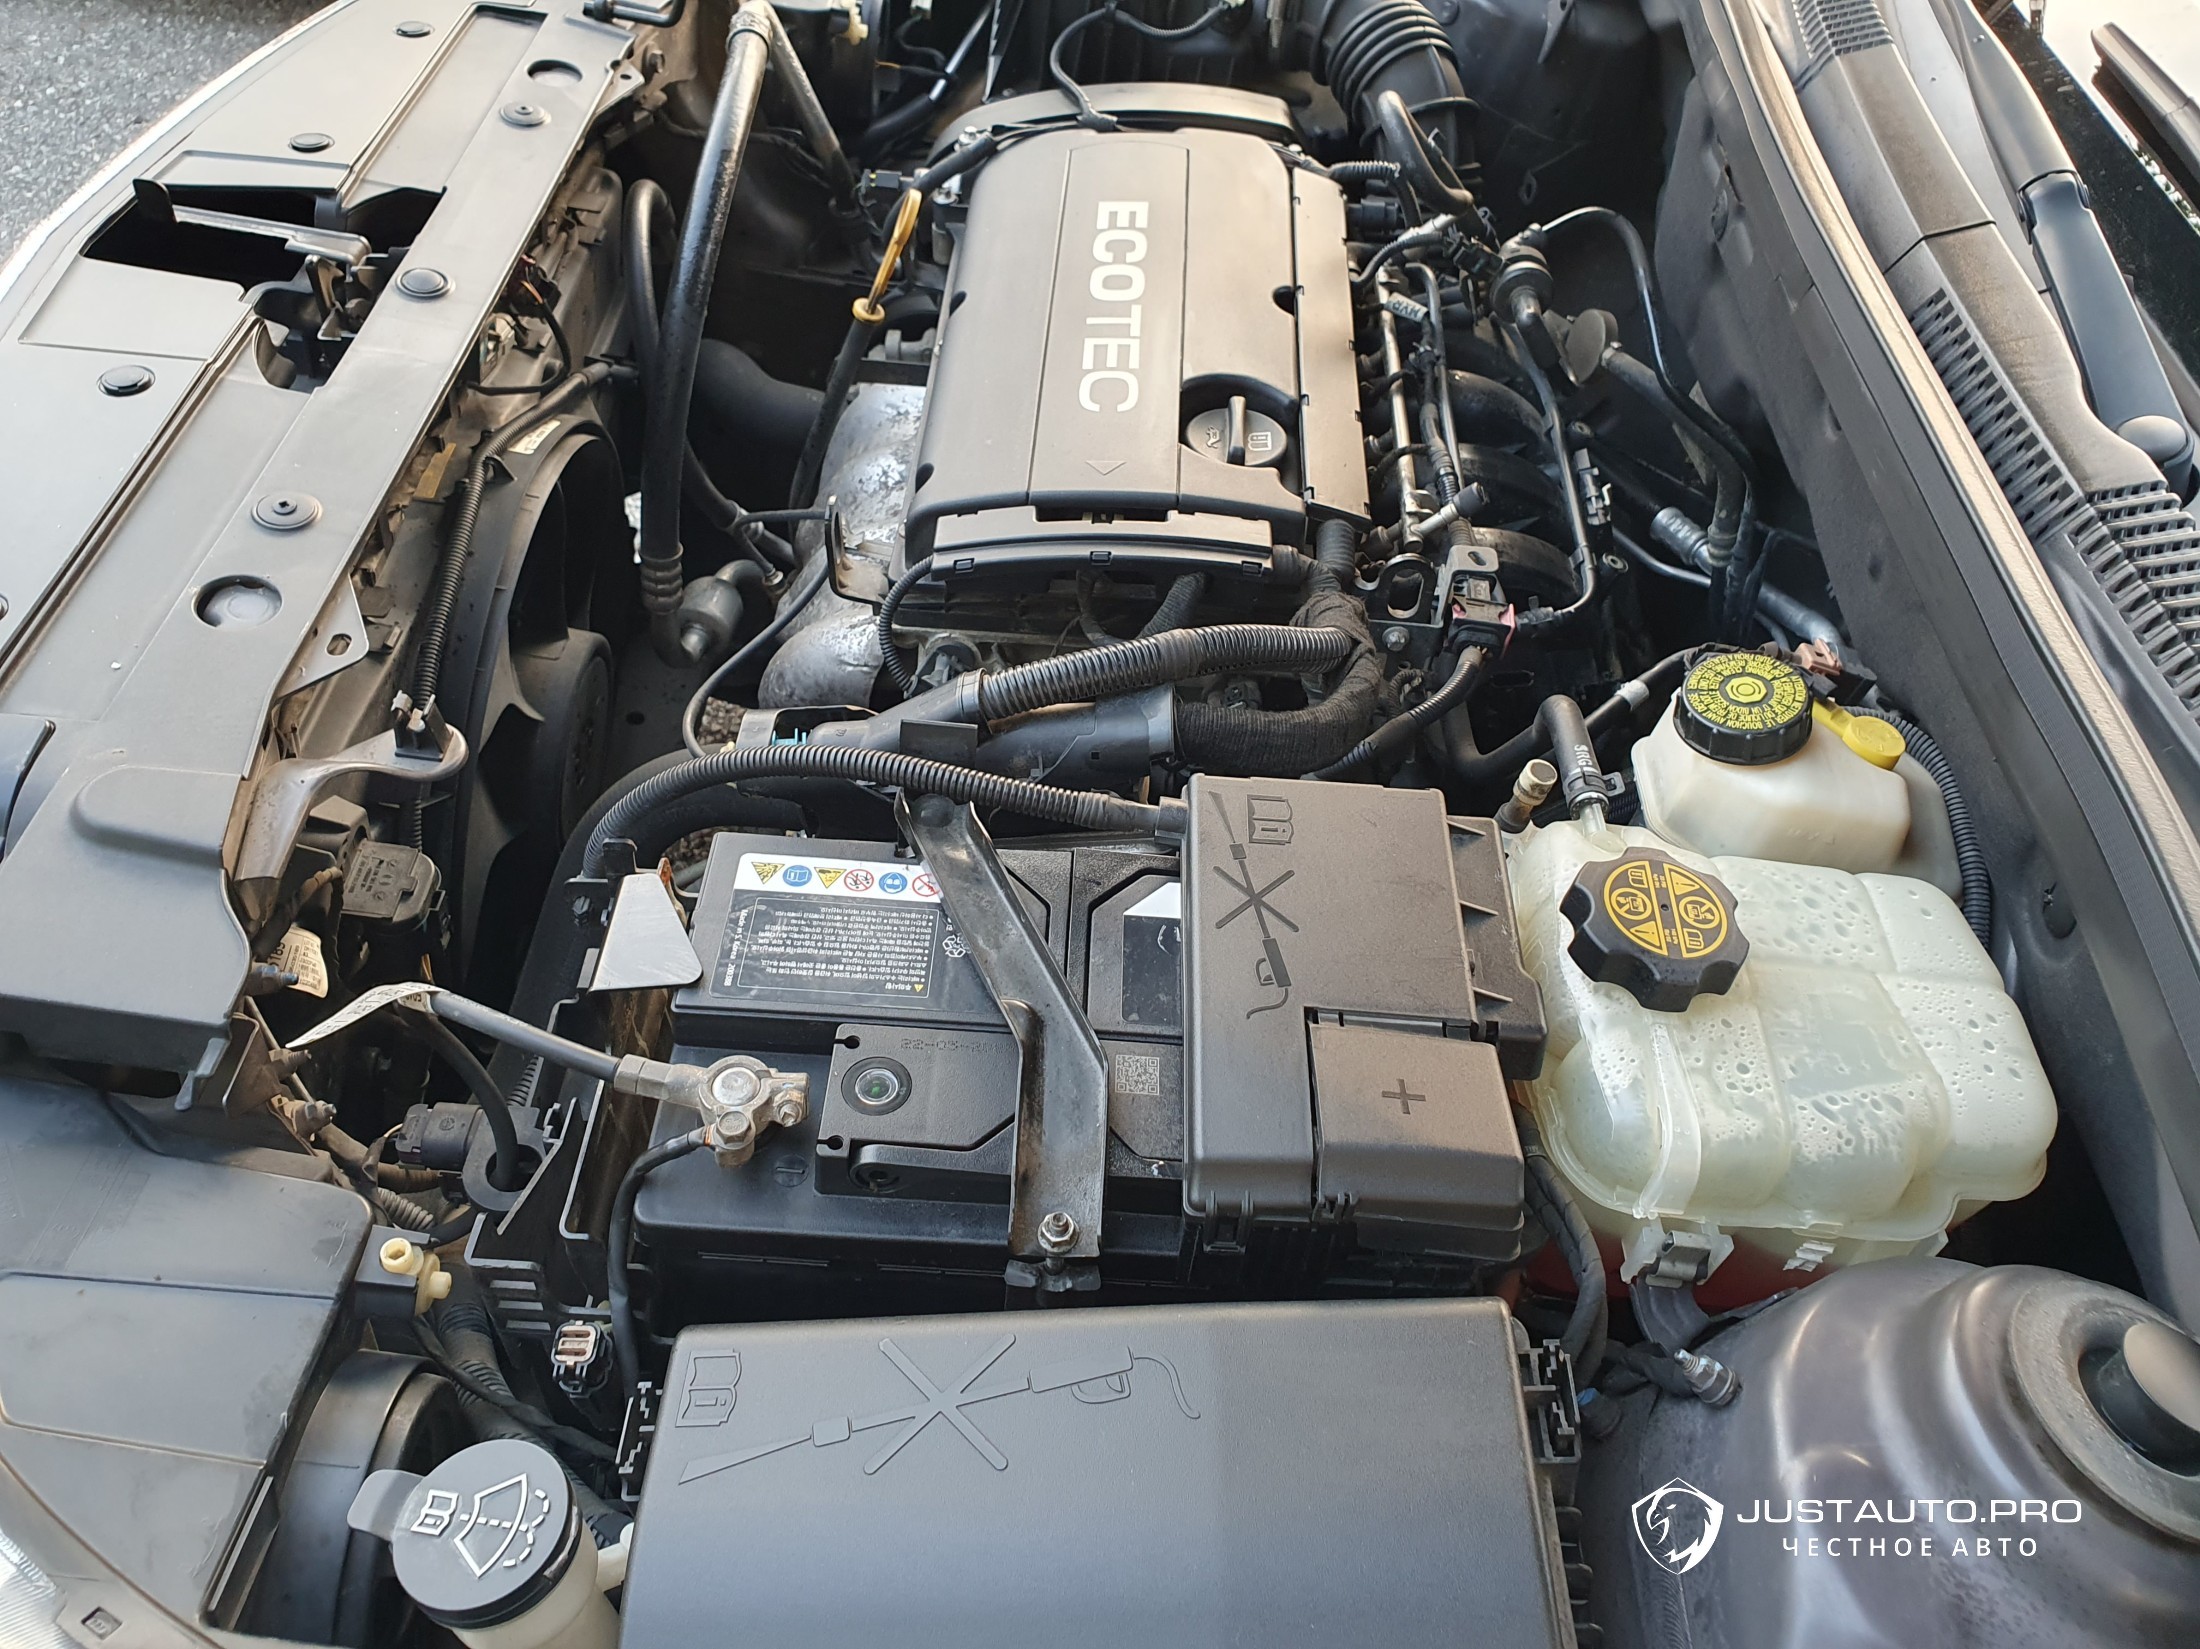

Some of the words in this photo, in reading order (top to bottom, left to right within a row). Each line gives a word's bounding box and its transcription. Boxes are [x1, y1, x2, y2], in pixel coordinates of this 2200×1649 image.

[1079, 201, 1149, 412] ECOTEC
[1700, 710, 1726, 725] AVANT
[1763, 718, 1777, 727] LE
[1724, 719, 1763, 729] BOUCHON
